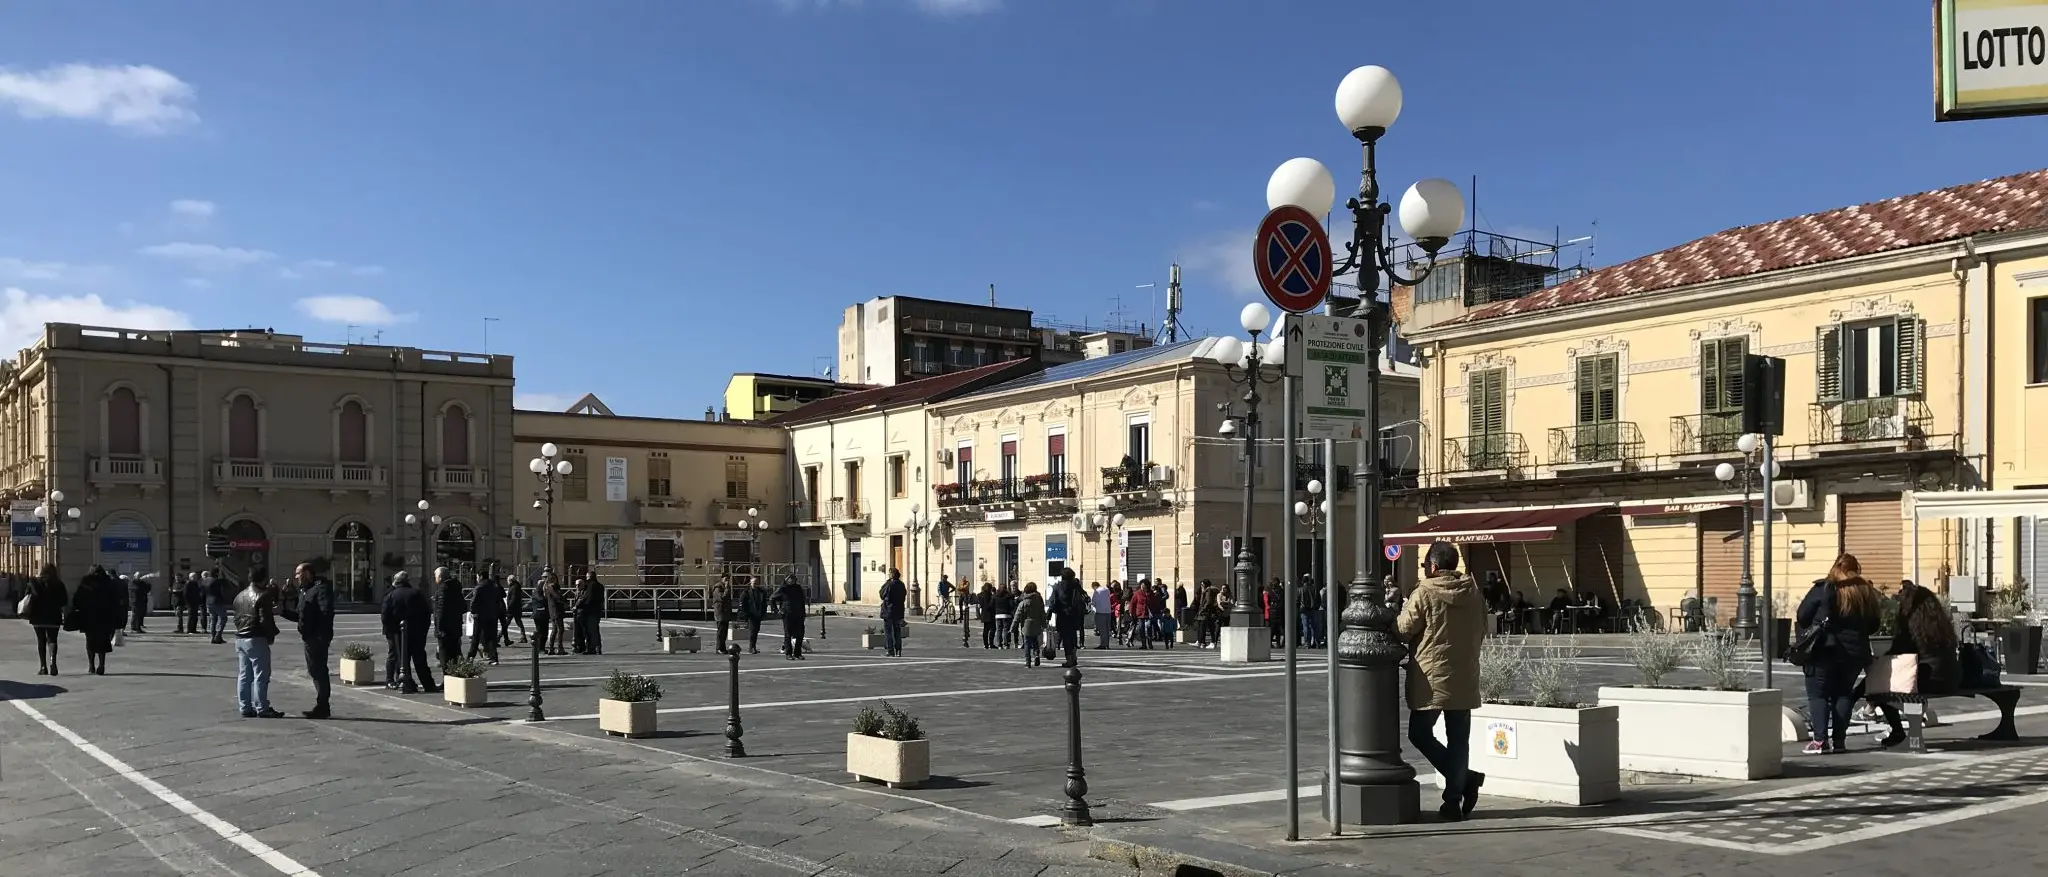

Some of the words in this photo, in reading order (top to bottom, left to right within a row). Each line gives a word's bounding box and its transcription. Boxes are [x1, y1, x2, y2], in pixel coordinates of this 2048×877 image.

[1963, 26, 2046, 70] LOTTO
[1307, 339, 1345, 350] PROTEZIONE
[1346, 342, 1365, 351] CIVILE
[1664, 505, 1680, 513] BAR
